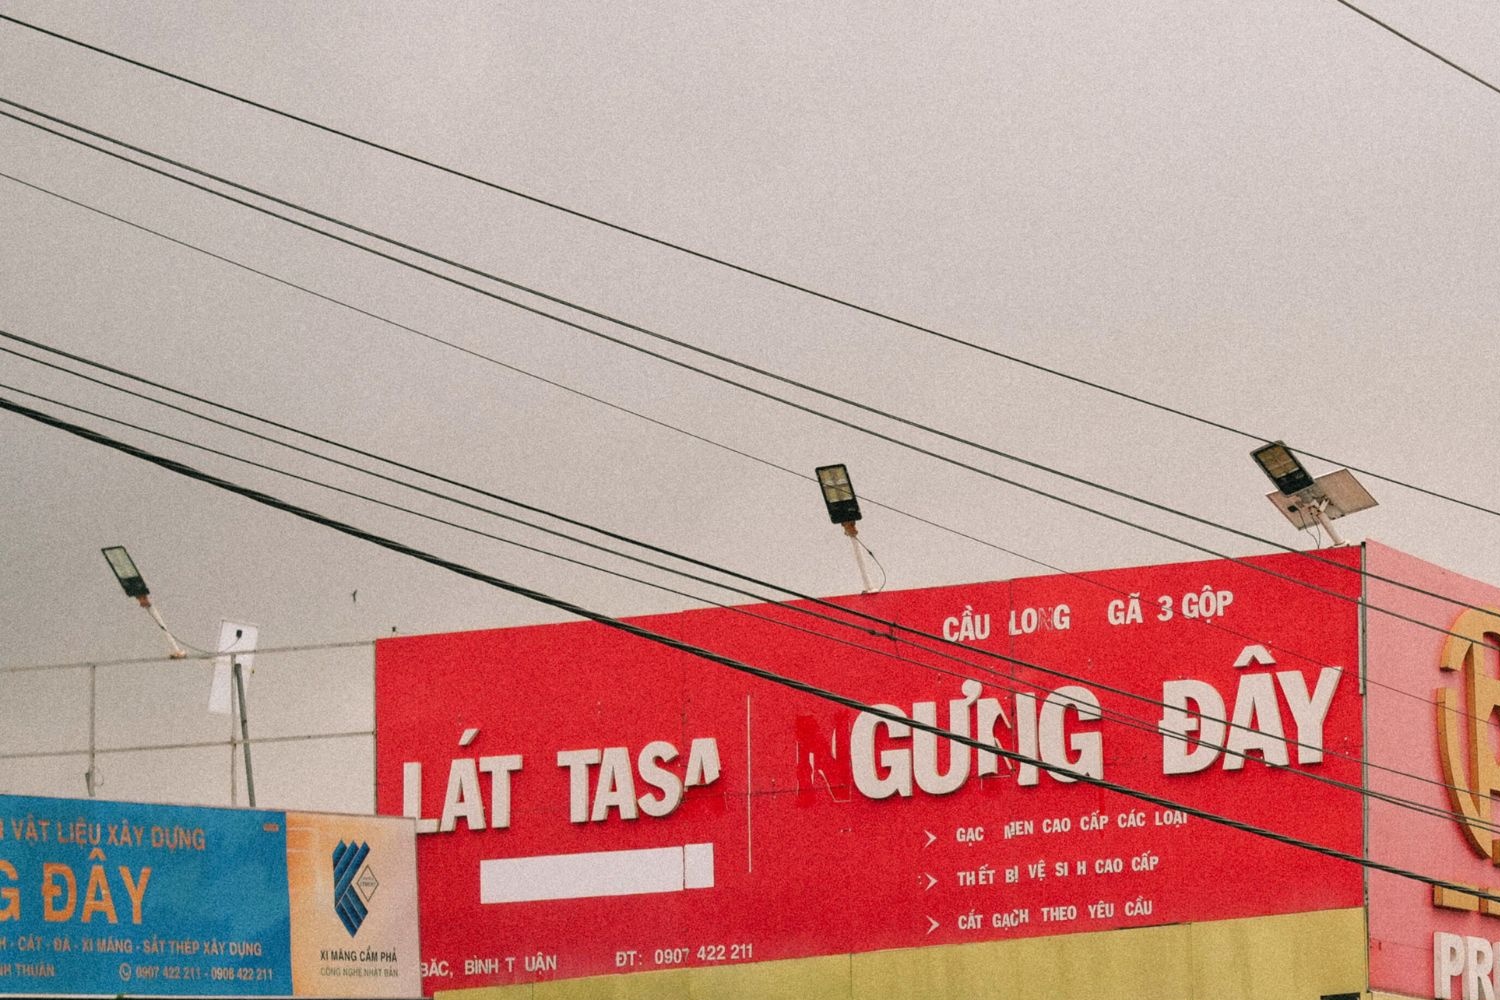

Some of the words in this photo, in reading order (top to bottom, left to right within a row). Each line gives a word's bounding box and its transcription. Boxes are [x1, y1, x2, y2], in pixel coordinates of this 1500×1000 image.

[943, 605, 990, 642] CẦU
[1108, 592, 1142, 625] GÃ
[1157, 596, 1173, 621] 3
[1182, 585, 1233, 623] GỘP
[1159, 644, 1343, 776] ĐÂY
[403, 728, 523, 834] LÁT
[557, 737, 721, 824] TASA
[12, 814, 50, 846] VẬT
[57, 817, 100, 850] LIỆU
[107, 819, 145, 848] XÂY
[152, 824, 206, 853] DỰNG
[1042, 818, 1071, 833] CAO
[1080, 810, 1108, 831] CẤP
[1117, 809, 1146, 828] CÁC
[1155, 809, 1188, 827] LOẠI
[1005, 866, 1019, 883] BỊ
[1028, 860, 1046, 881] VỆ
[1095, 859, 1123, 874] CAO
[1131, 851, 1159, 872] CẤP
[41, 847, 152, 924] ĐÂY
[958, 910, 983, 930] CẮT
[992, 909, 1029, 931] GẠCH
[1041, 905, 1077, 922] THEO
[1088, 900, 1115, 919] YÊU
[1124, 895, 1152, 917] CẦU
[169, 937, 199, 954] THÉP
[204, 938, 226, 956] XÂY
[320, 950, 328, 961] XI
[465, 955, 499, 975] BÌNH
[615, 951, 642, 967] ĐT:
[655, 948, 690, 964] 0907
[697, 946, 725, 961] 422
[730, 944, 753, 959] 211
[163, 967, 180, 979] 422
[236, 968, 253, 980] 422
[256, 968, 273, 981] 211
